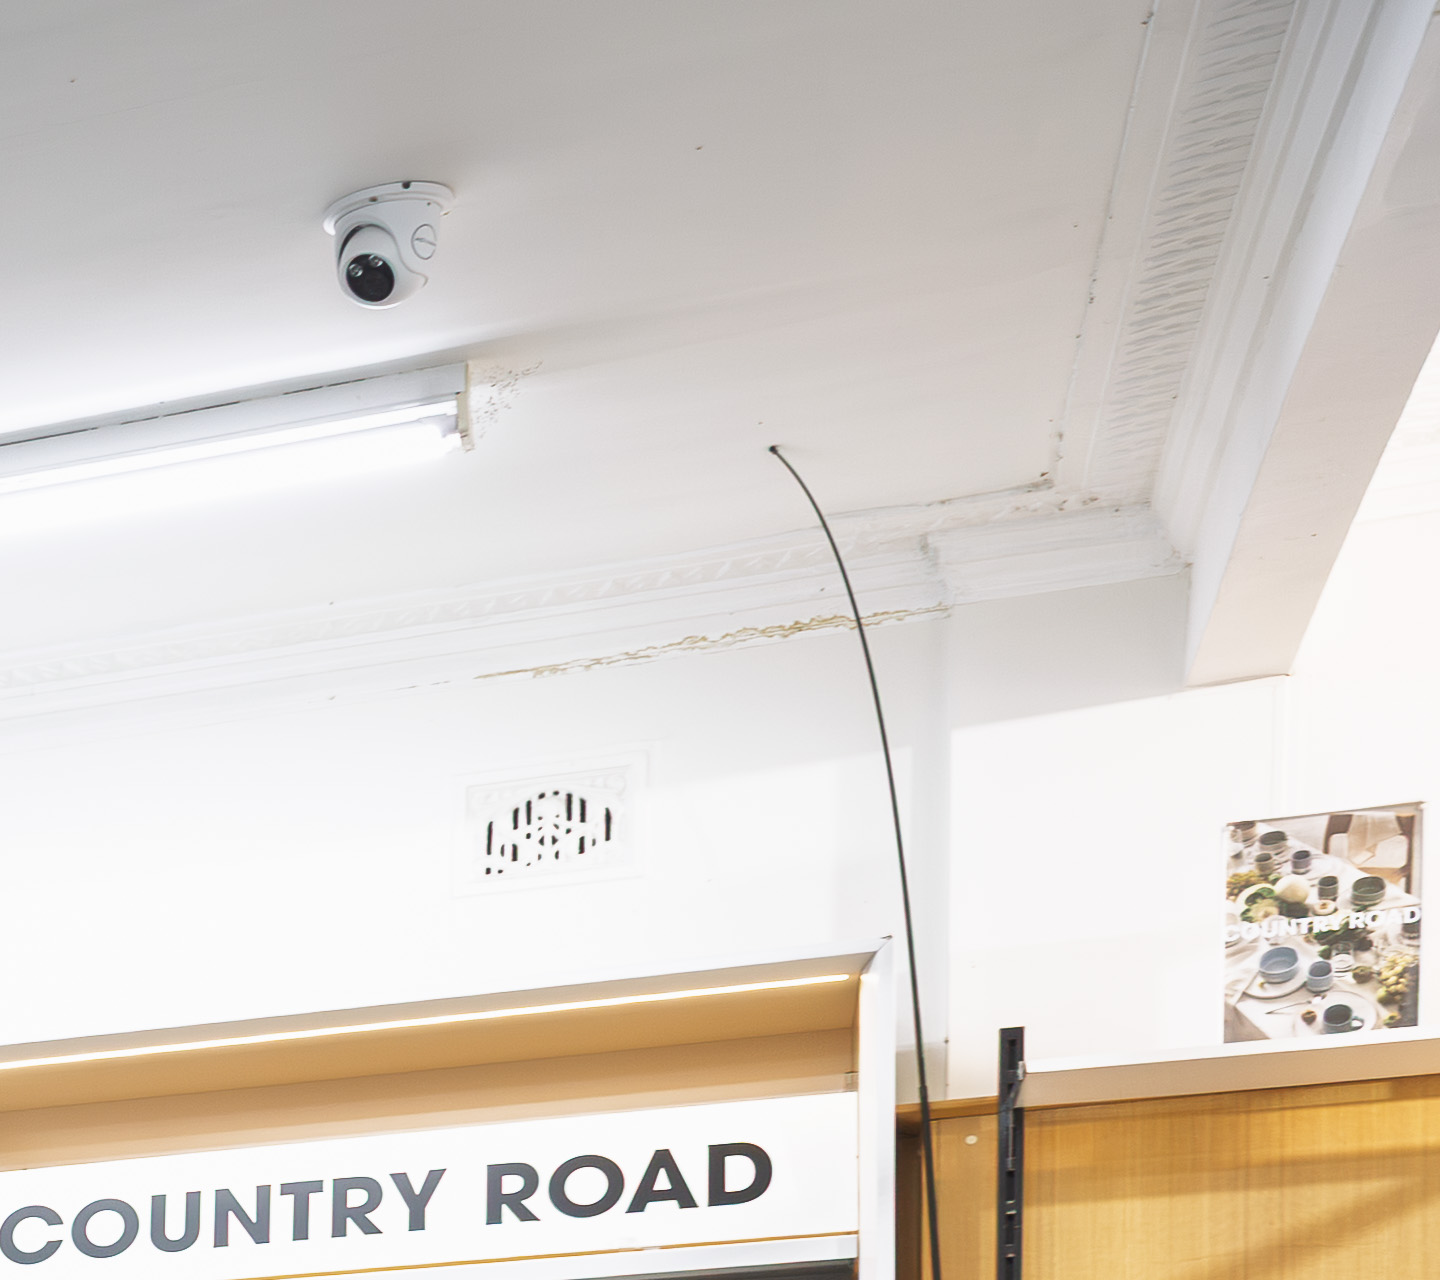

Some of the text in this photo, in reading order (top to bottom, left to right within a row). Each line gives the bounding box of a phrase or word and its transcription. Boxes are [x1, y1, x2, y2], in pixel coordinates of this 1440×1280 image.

[1225, 907, 1421, 942] COUNTRY ROAD
[0, 1143, 773, 1265] COUNTRY ROAD
